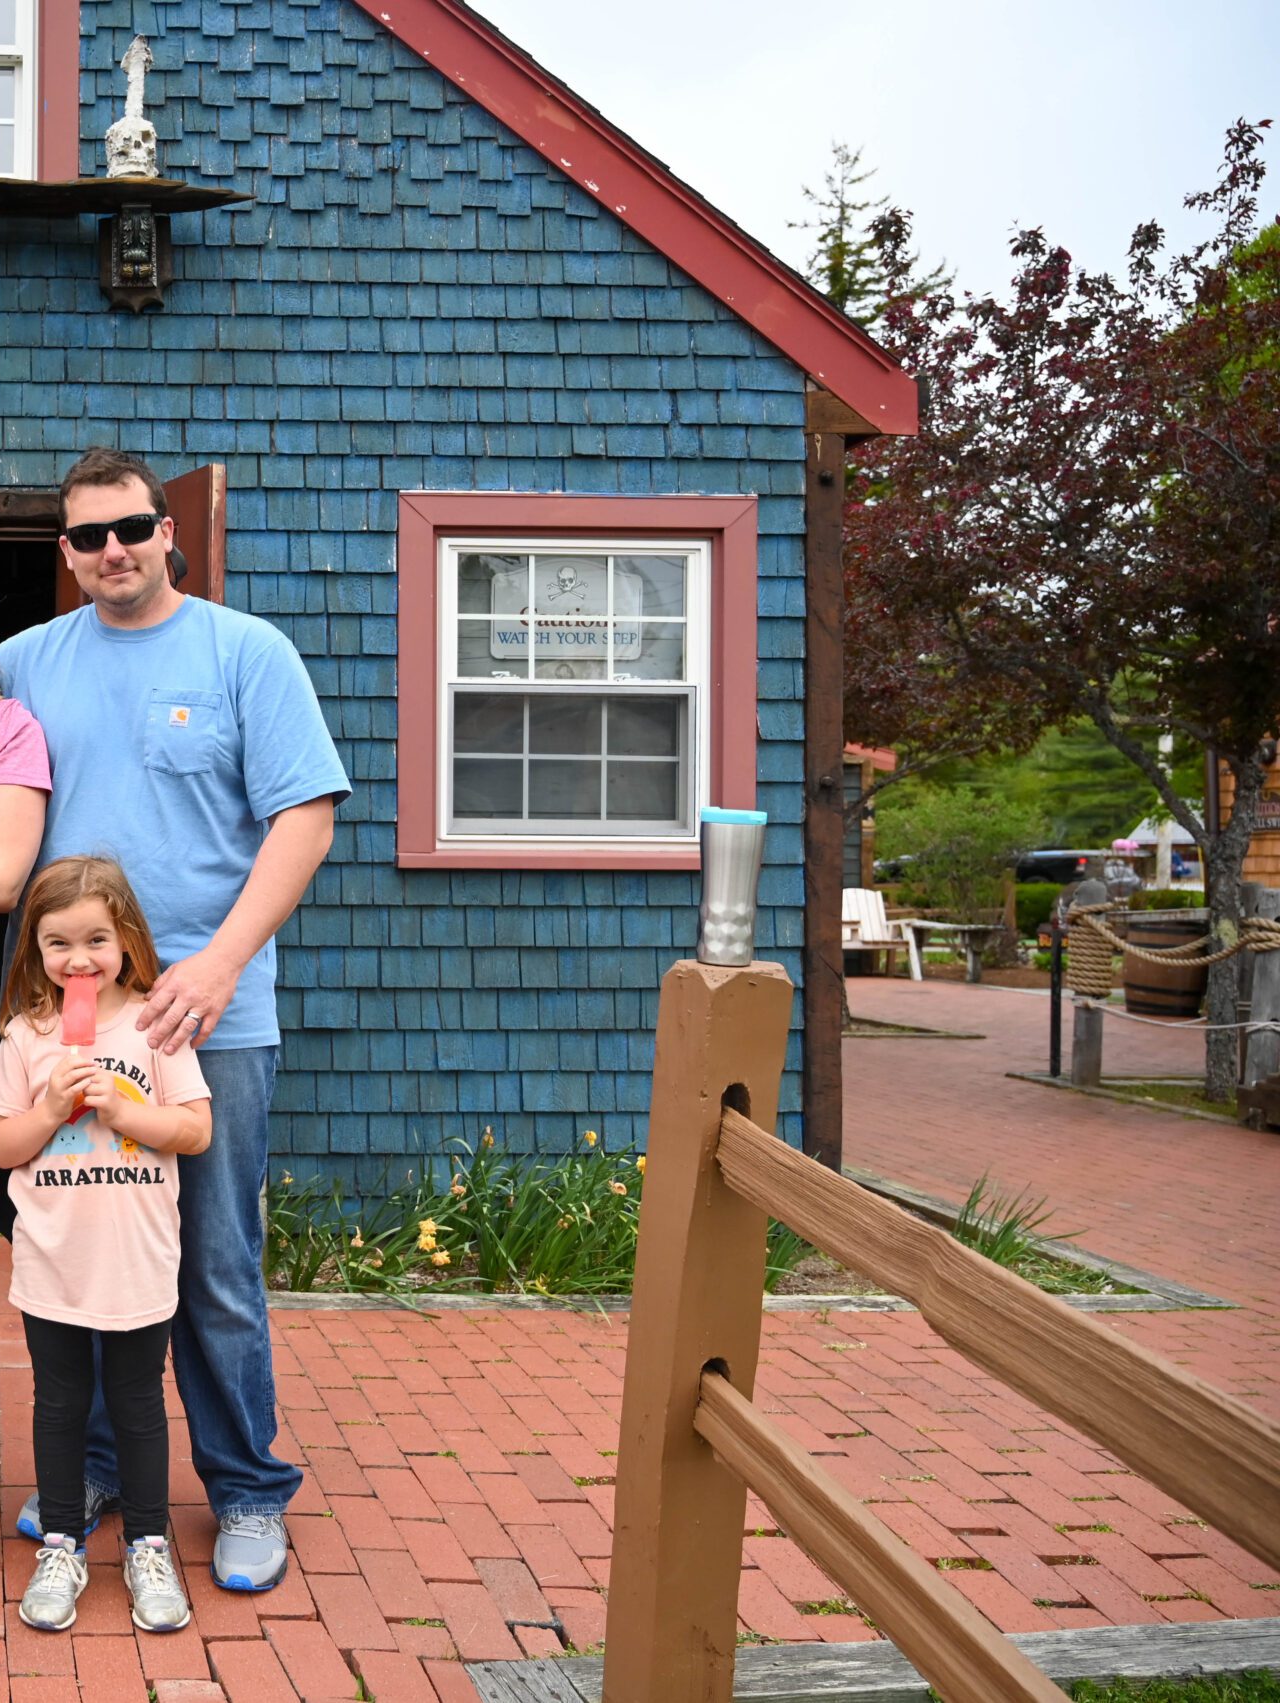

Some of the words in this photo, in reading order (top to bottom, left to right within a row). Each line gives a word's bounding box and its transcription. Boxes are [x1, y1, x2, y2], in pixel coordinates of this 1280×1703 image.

[556, 632, 597, 645] YOUR
[602, 632, 637, 645] STEP
[35, 1166, 165, 1187] IRRATIONAL
